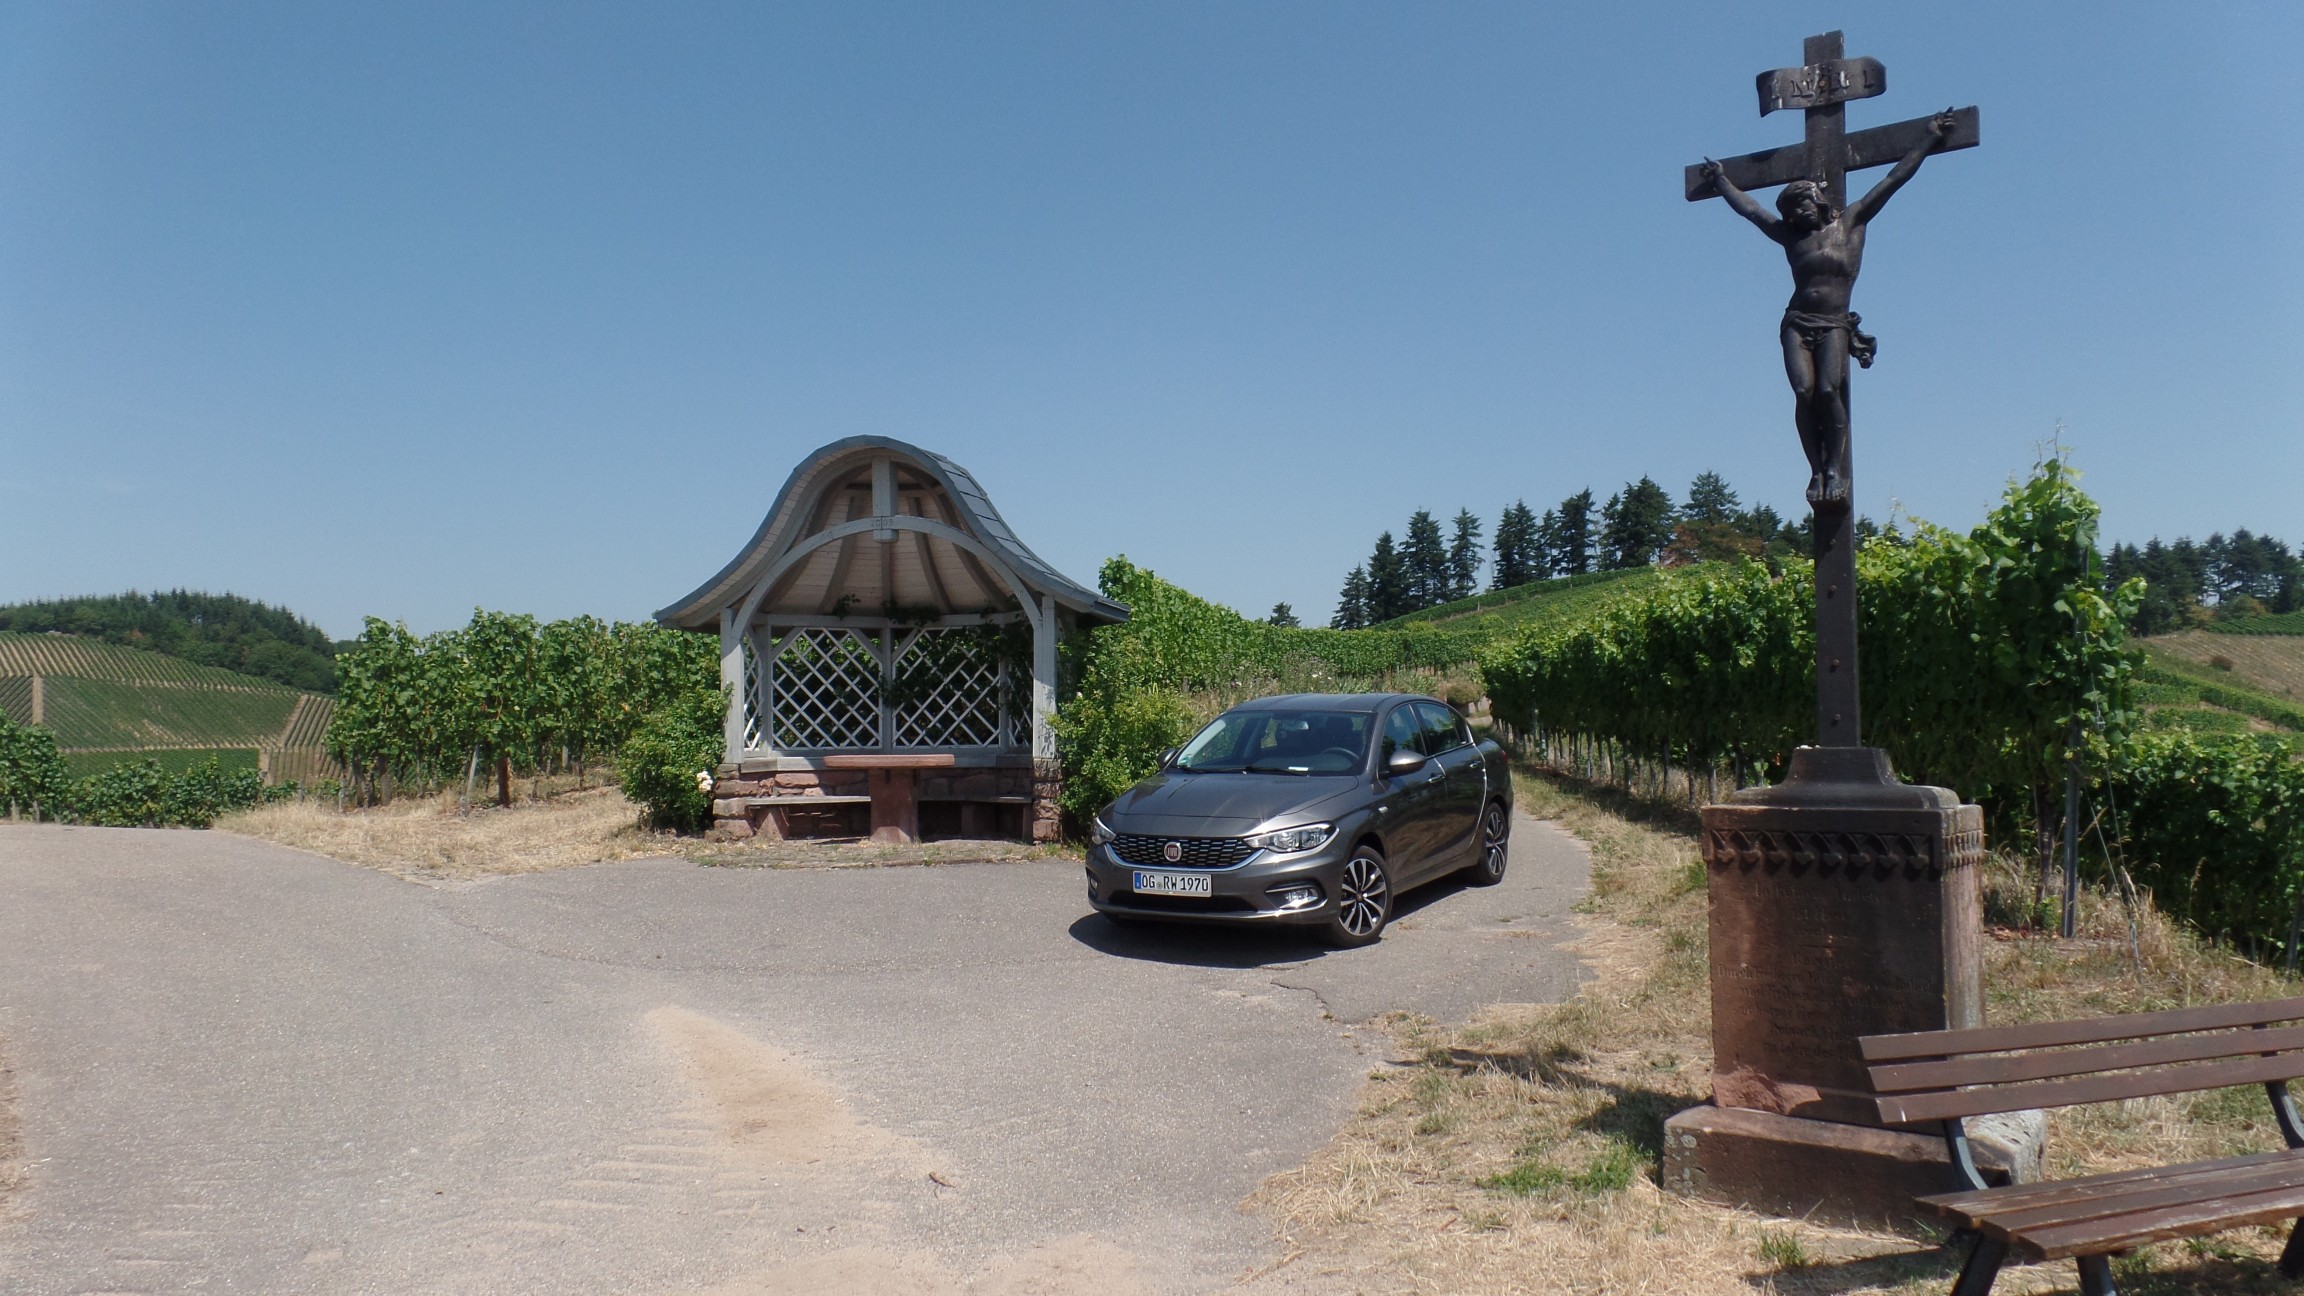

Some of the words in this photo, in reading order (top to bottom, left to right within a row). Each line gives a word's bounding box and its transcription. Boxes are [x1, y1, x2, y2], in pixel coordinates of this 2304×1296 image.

[1141, 874, 1155, 889] OG
[1163, 876, 1177, 890] RW
[1180, 877, 1209, 892] 1970
